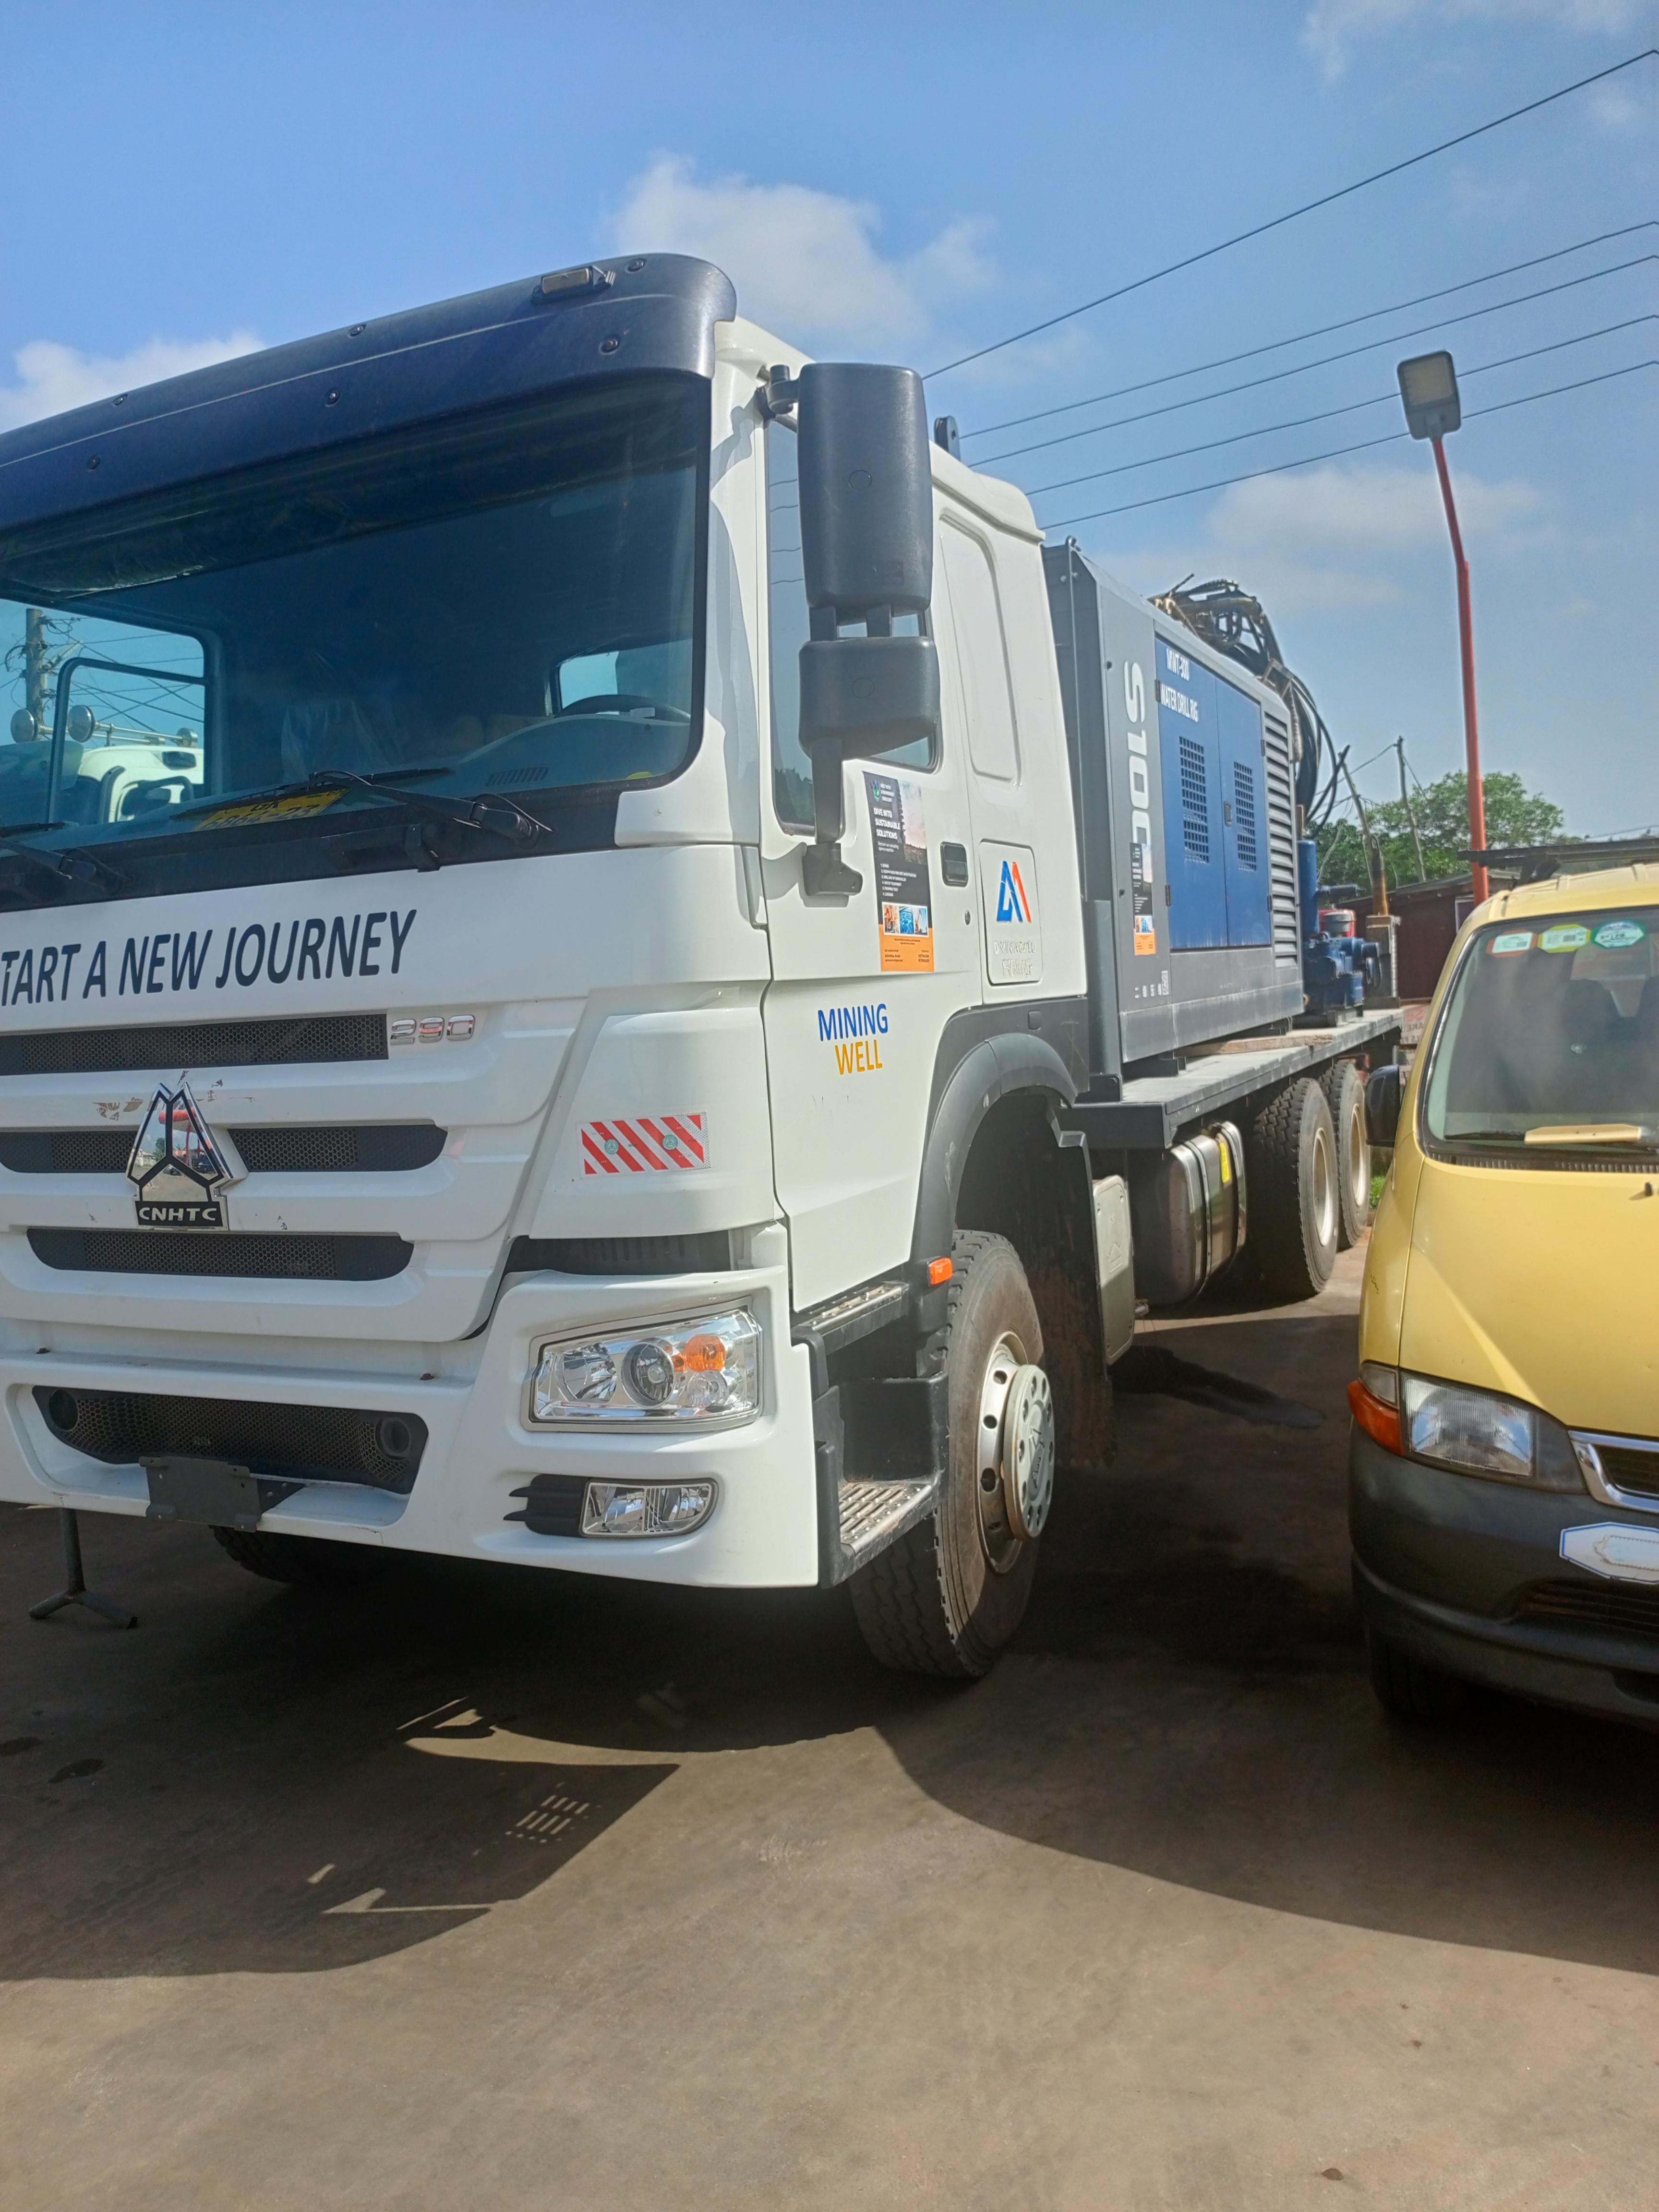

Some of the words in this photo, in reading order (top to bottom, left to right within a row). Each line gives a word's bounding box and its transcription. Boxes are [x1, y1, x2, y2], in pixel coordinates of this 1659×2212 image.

[1166, 648, 1190, 681] MWT-300
[1177, 692, 1190, 719] DRILL
[1190, 699, 1199, 722] RIG
[874, 807, 883, 816] DIVE
[875, 818, 901, 830] SUSTAINABLE
[876, 829, 898, 839] SOLUTIONS
[83, 940, 107, 999] A
[119, 929, 213, 996] NEW
[216, 909, 418, 989] JOURNEY
[817, 1003, 889, 1042] MINING
[834, 1039, 883, 1075] WELL
[139, 1206, 217, 1222] CNHTC
